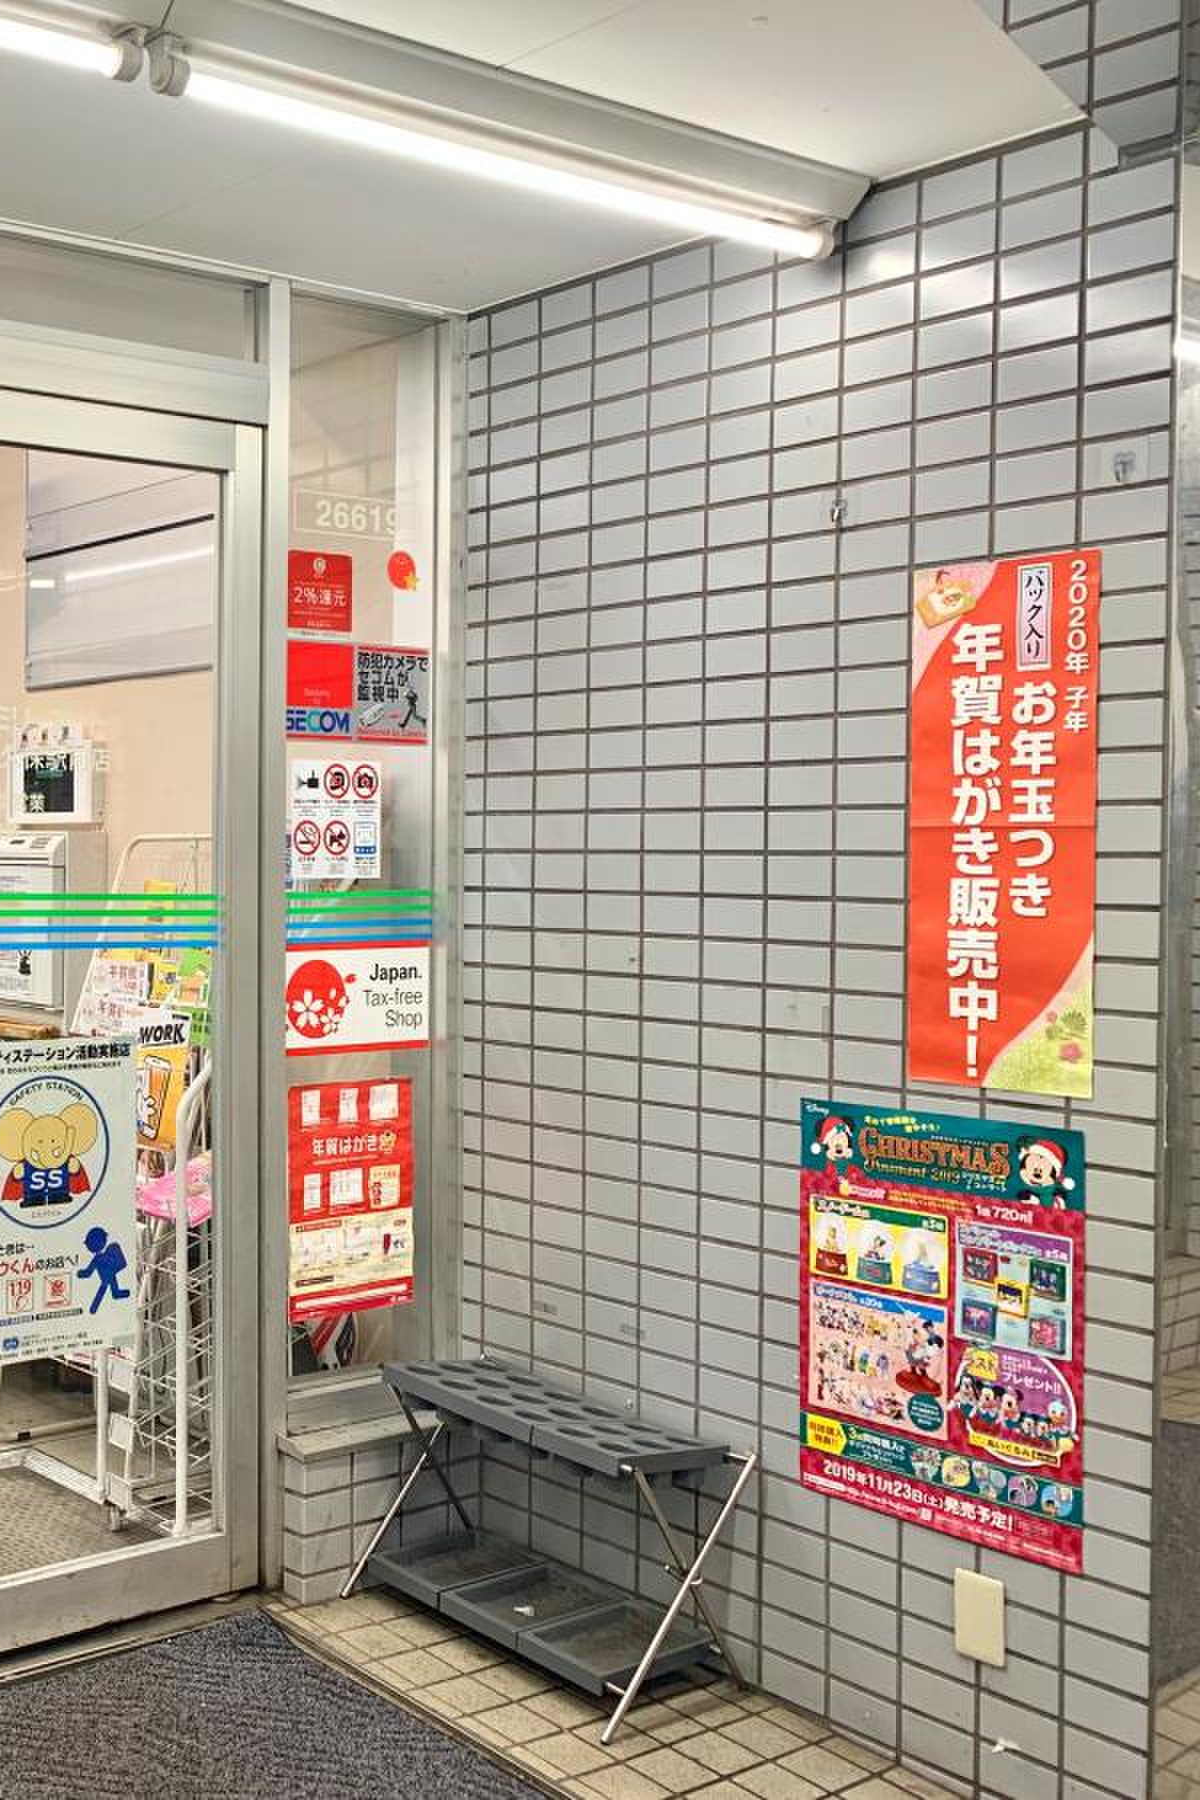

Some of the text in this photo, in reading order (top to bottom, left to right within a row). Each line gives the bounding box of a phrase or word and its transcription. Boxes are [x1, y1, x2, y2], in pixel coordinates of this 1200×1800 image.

[1024, 569, 1045, 658] パック入り
[1063, 560, 1089, 733] 2020年 子年
[357, 652, 429, 672] 防犯カメラで
[357, 671, 410, 687] セコムが
[357, 686, 400, 702] 監視中
[286, 709, 350, 733] SECOM
[1008, 681, 1057, 917] お年玉つき
[946, 623, 1004, 1078] 年賀はがき販売中!
[369, 962, 422, 985] Japan.
[362, 986, 423, 1007] Tax-free
[385, 1008, 423, 1031] Shop
[858, 1126, 1011, 1178] CHRISTMAS
[29, 1169, 64, 1191] SS
[9, 1279, 32, 1297] 119
